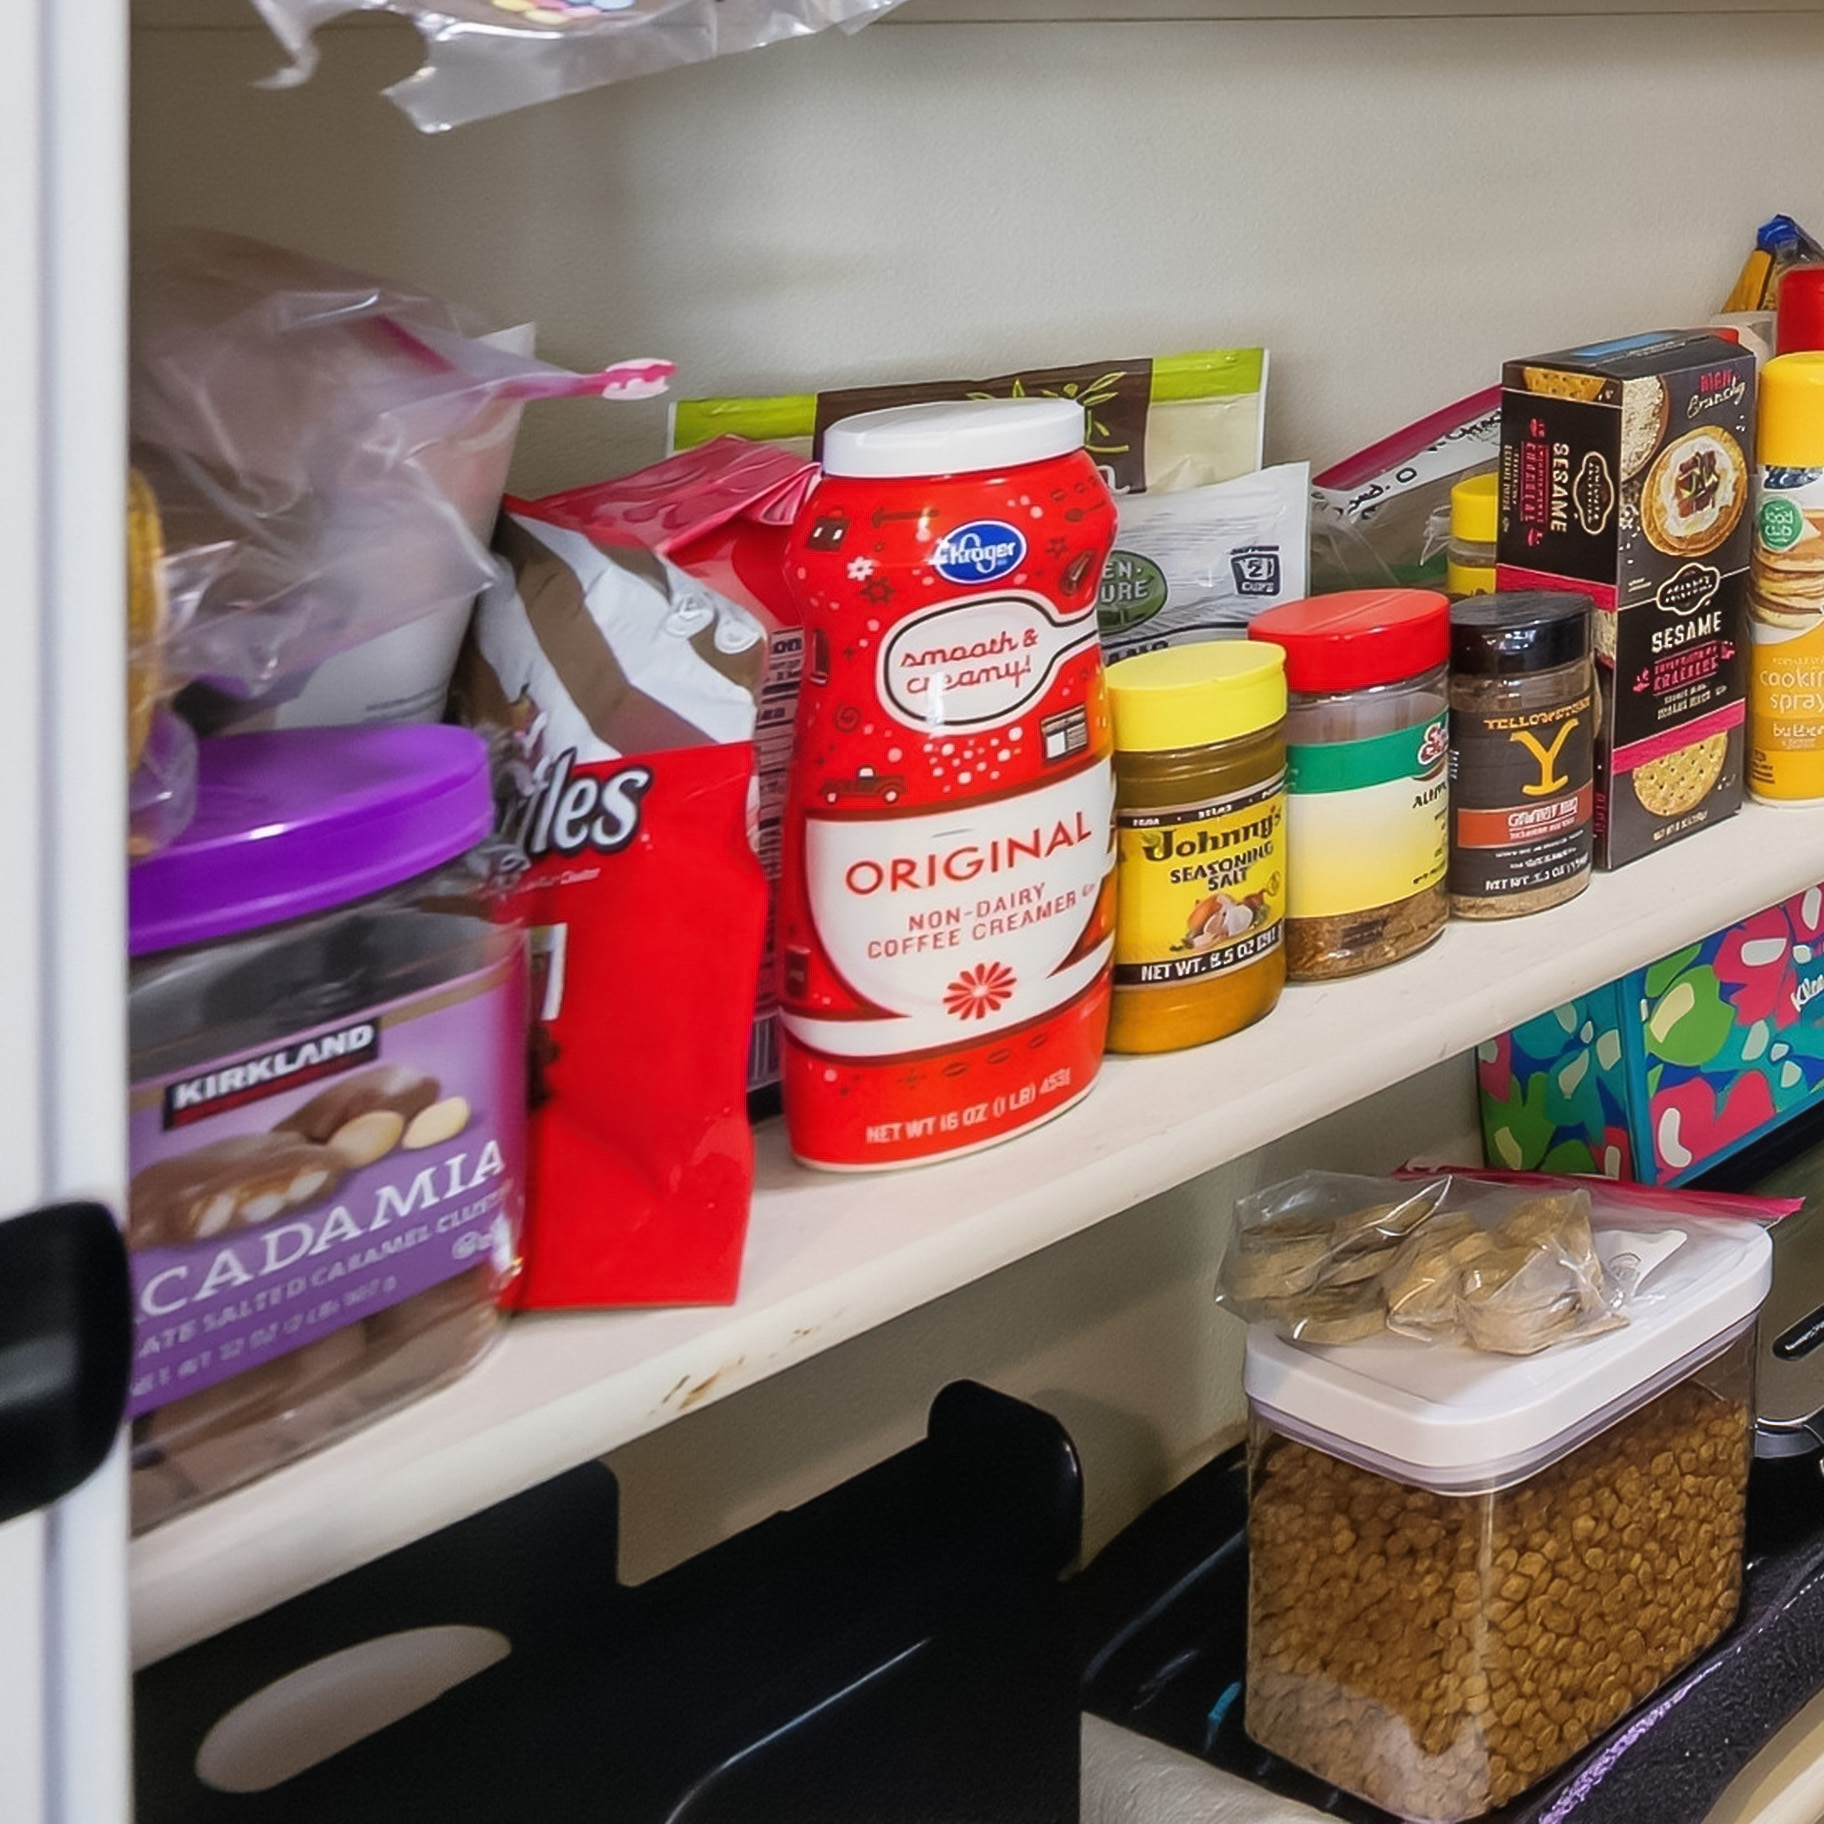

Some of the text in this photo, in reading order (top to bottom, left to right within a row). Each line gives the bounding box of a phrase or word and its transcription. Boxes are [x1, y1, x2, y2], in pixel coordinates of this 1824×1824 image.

[1550, 442, 1570, 534] SESAME
[942, 539, 1018, 569] Kroger
[899, 627, 1038, 670] smooth &
[1650, 612, 1724, 655] SESAME
[905, 655, 1034, 697] creamy!
[1509, 718, 1580, 797] Y
[845, 811, 1092, 896] ORIGINAL
[1142, 805, 1283, 864] Johnny's
[1170, 842, 1274, 884] SEASONING
[1207, 867, 1248, 892] SALT
[866, 892, 1071, 960] COFFEE CREAMER
[907, 881, 1046, 934] NON-DAIRY
[1141, 962, 1171, 982] NET
[1175, 953, 1207, 976] WT.
[172, 1022, 377, 1109] KIRKLAND
[140, 1139, 504, 1316] CADAMIA
